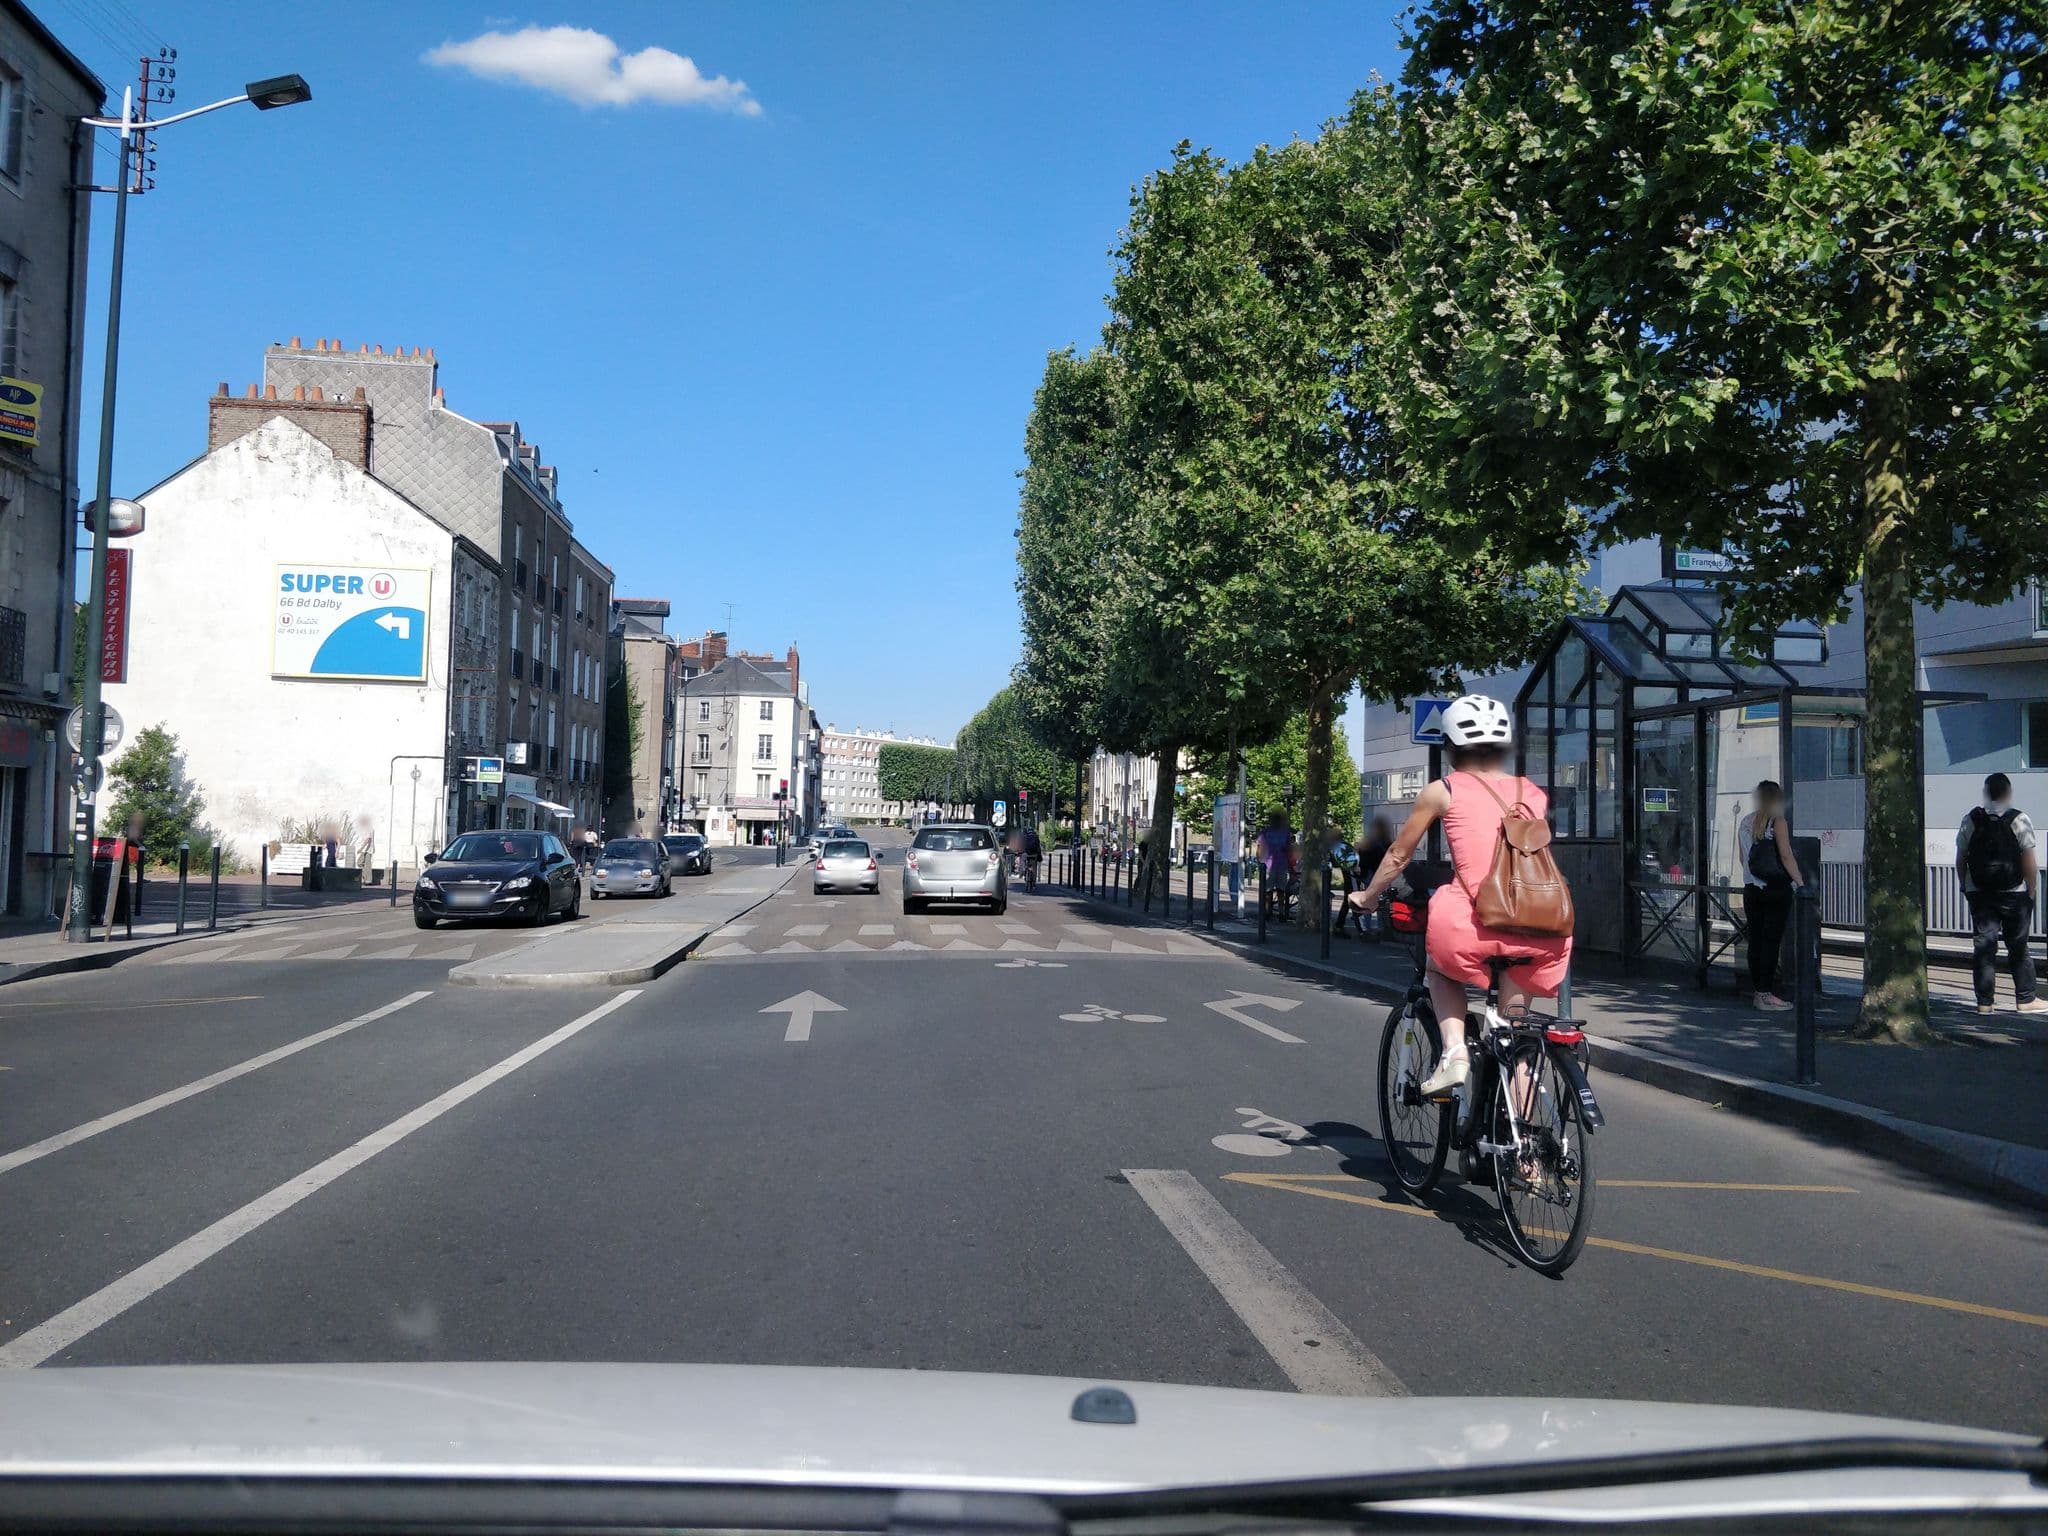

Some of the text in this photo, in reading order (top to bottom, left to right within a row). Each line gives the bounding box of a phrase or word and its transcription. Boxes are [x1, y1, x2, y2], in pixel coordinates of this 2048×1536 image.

[1691, 557, 1723, 568] François
[108, 569, 120, 586] LE
[280, 573, 390, 595] SUPER U
[280, 597, 342, 611] 66 Bd Dalby
[282, 616, 290, 625] U
[103, 589, 120, 677] STALINGRAD
